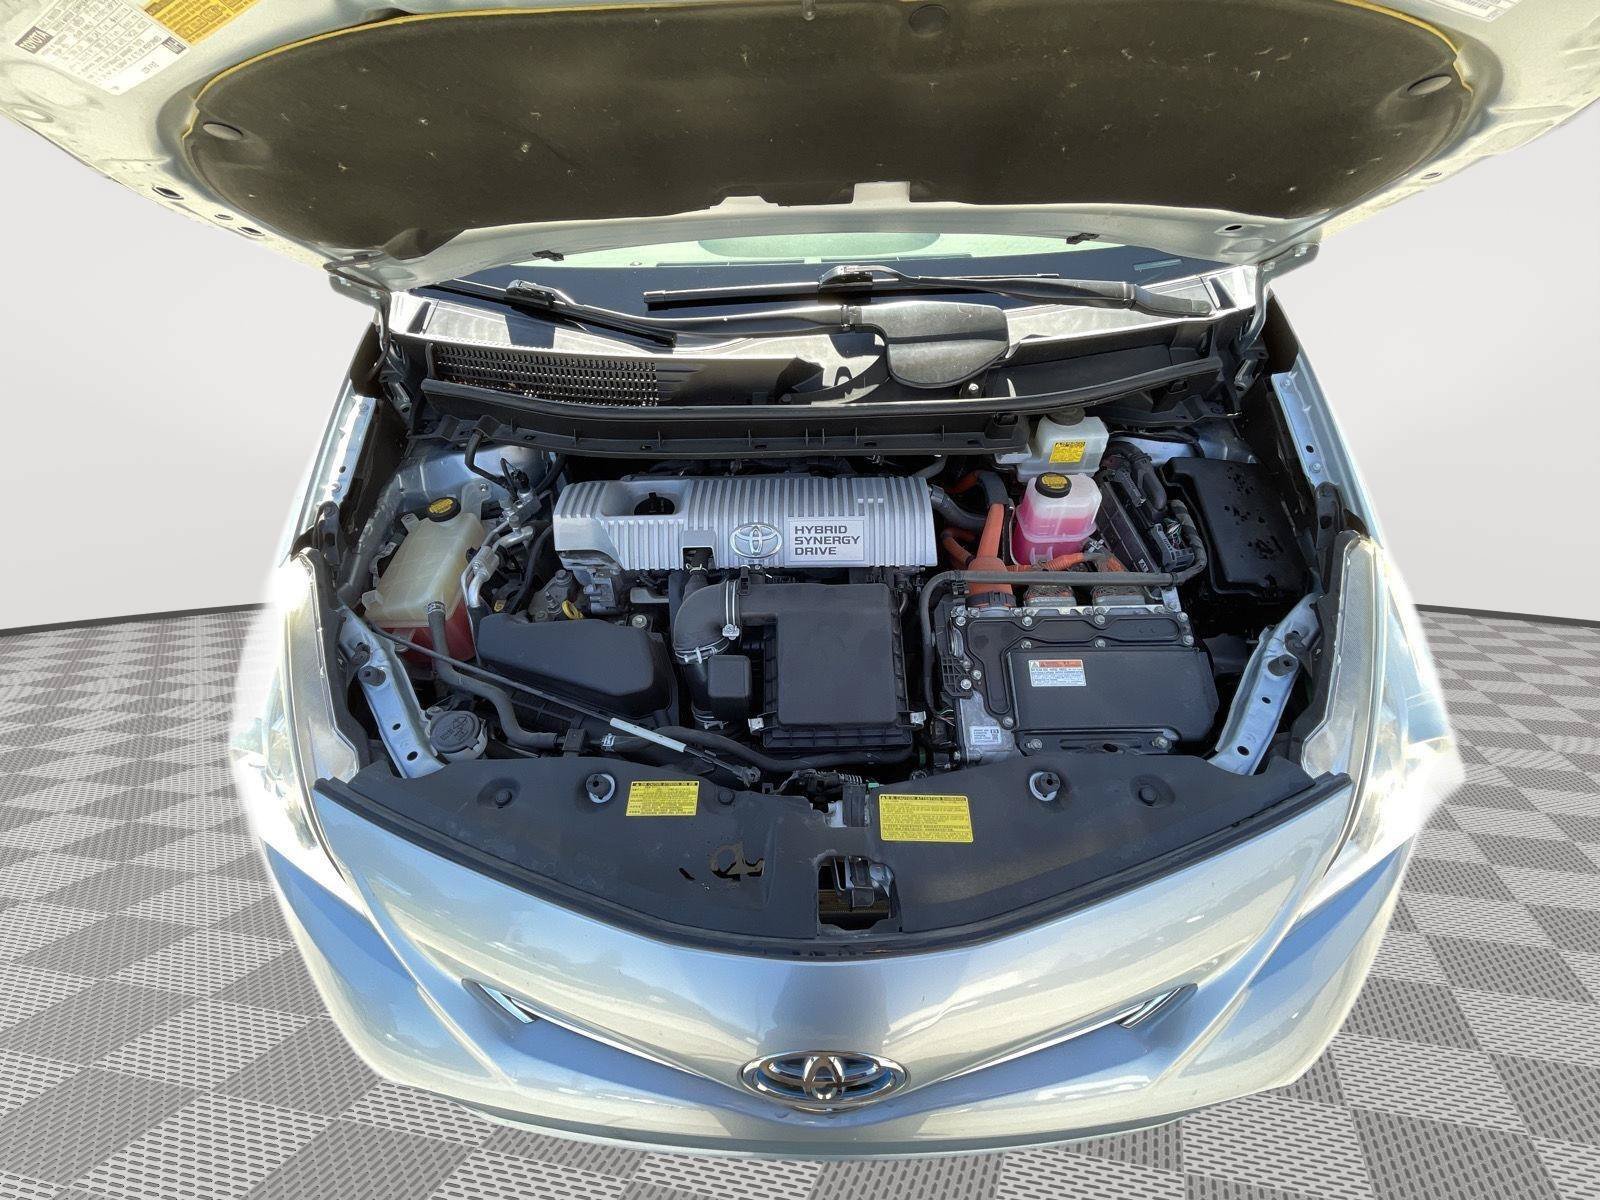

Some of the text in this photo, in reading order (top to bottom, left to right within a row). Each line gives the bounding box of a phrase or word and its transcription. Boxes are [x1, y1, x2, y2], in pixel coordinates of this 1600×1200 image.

[795, 525, 848, 534] HYBRID
[795, 535, 861, 545] SYNERGY
[795, 547, 837, 556] DRIVE
